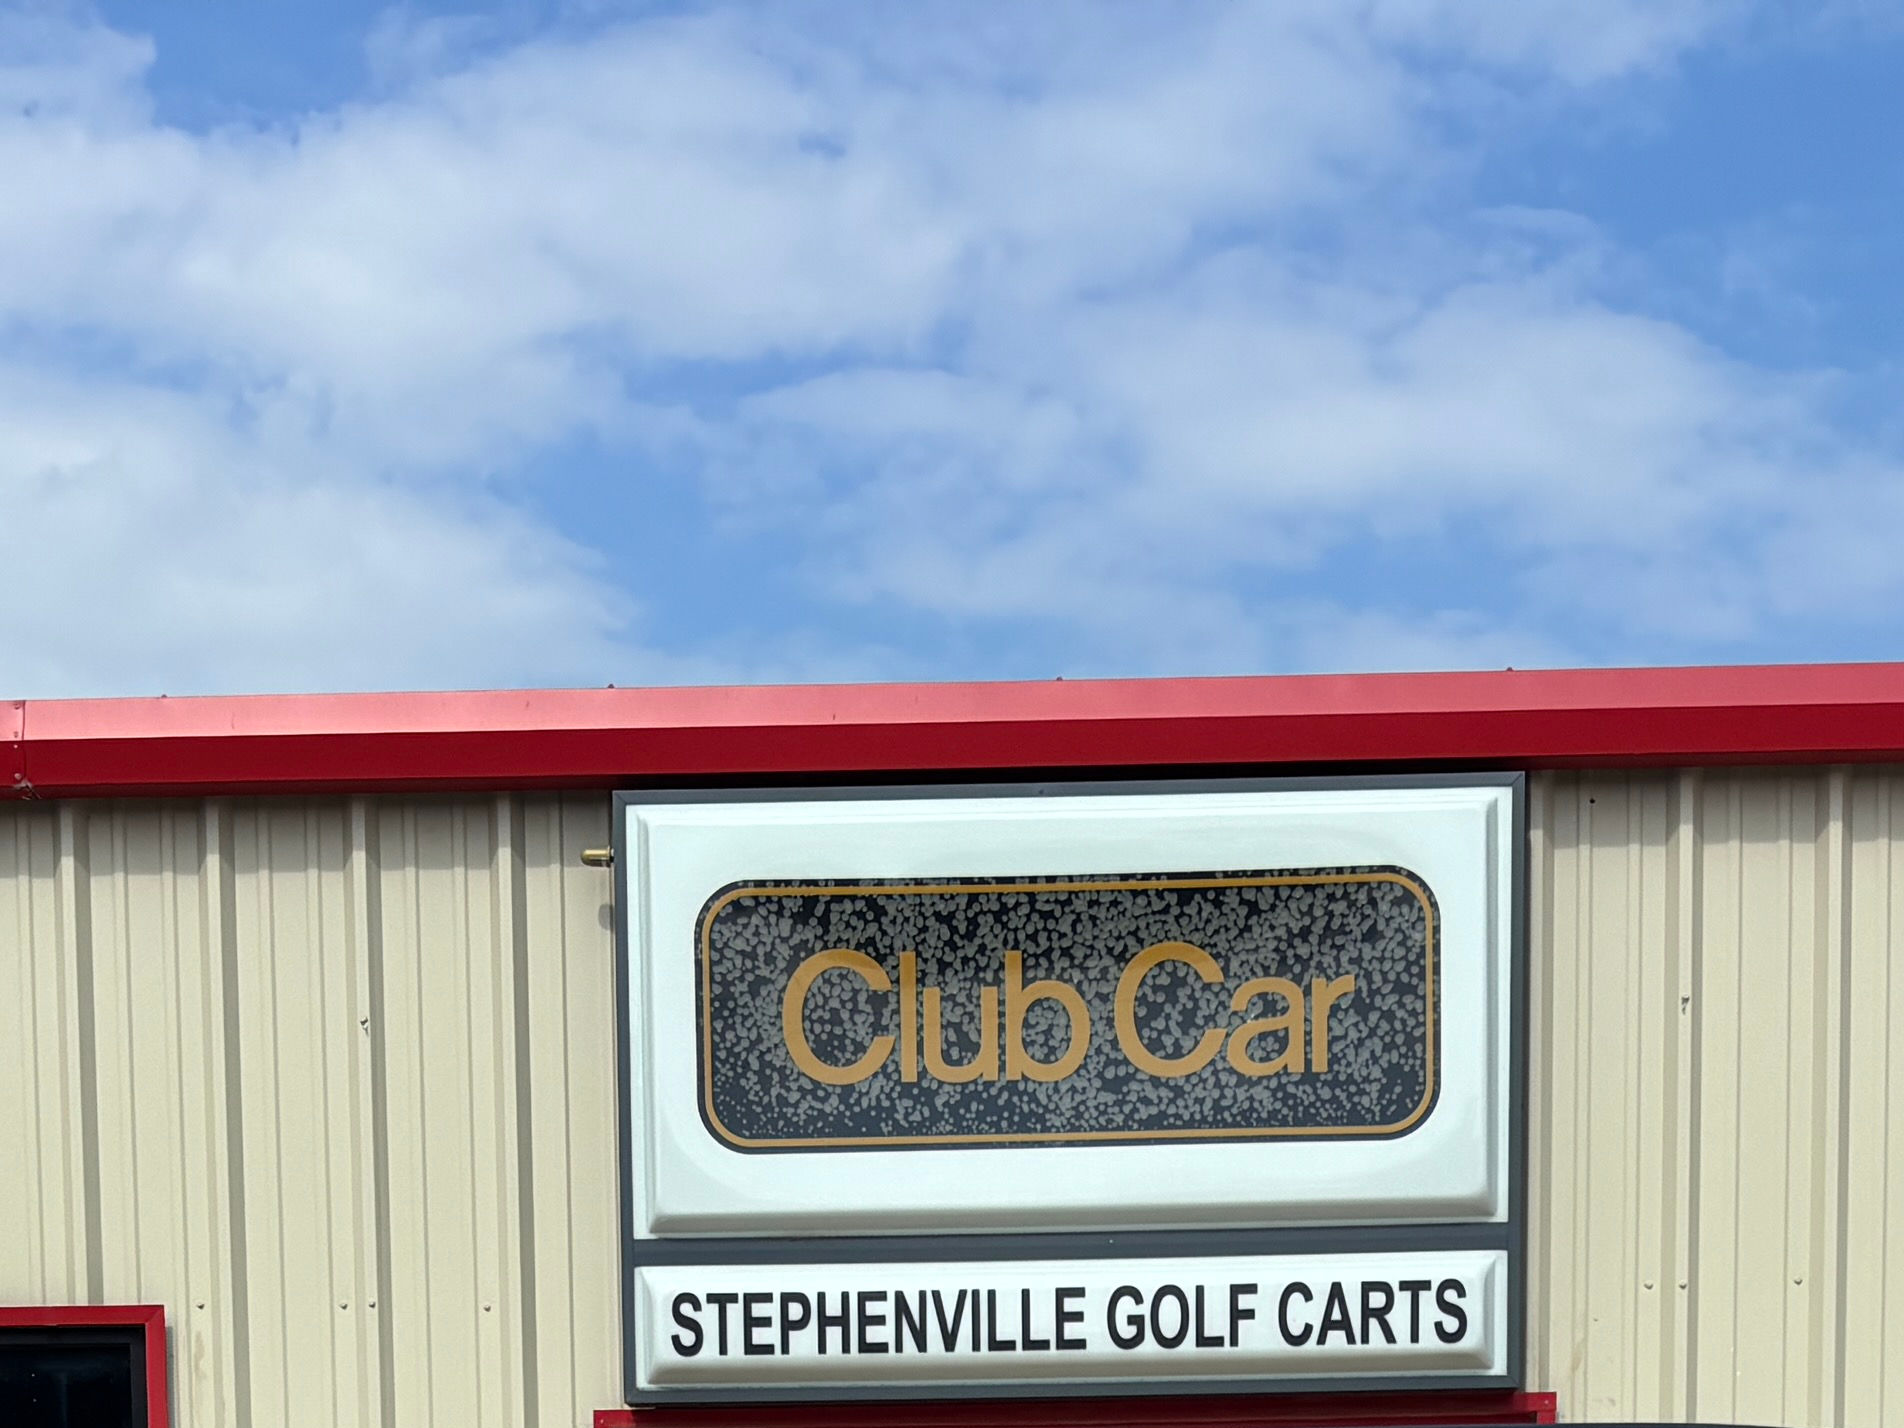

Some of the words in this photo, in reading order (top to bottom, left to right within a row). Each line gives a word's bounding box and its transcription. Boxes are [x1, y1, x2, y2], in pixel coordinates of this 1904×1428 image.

[781, 948, 1092, 1086] Club
[1114, 940, 1356, 1078] Car
[670, 1286, 1088, 1358] STEPHENVILLE
[1106, 1283, 1259, 1351] GOLF
[1277, 1278, 1469, 1348] CARTS
